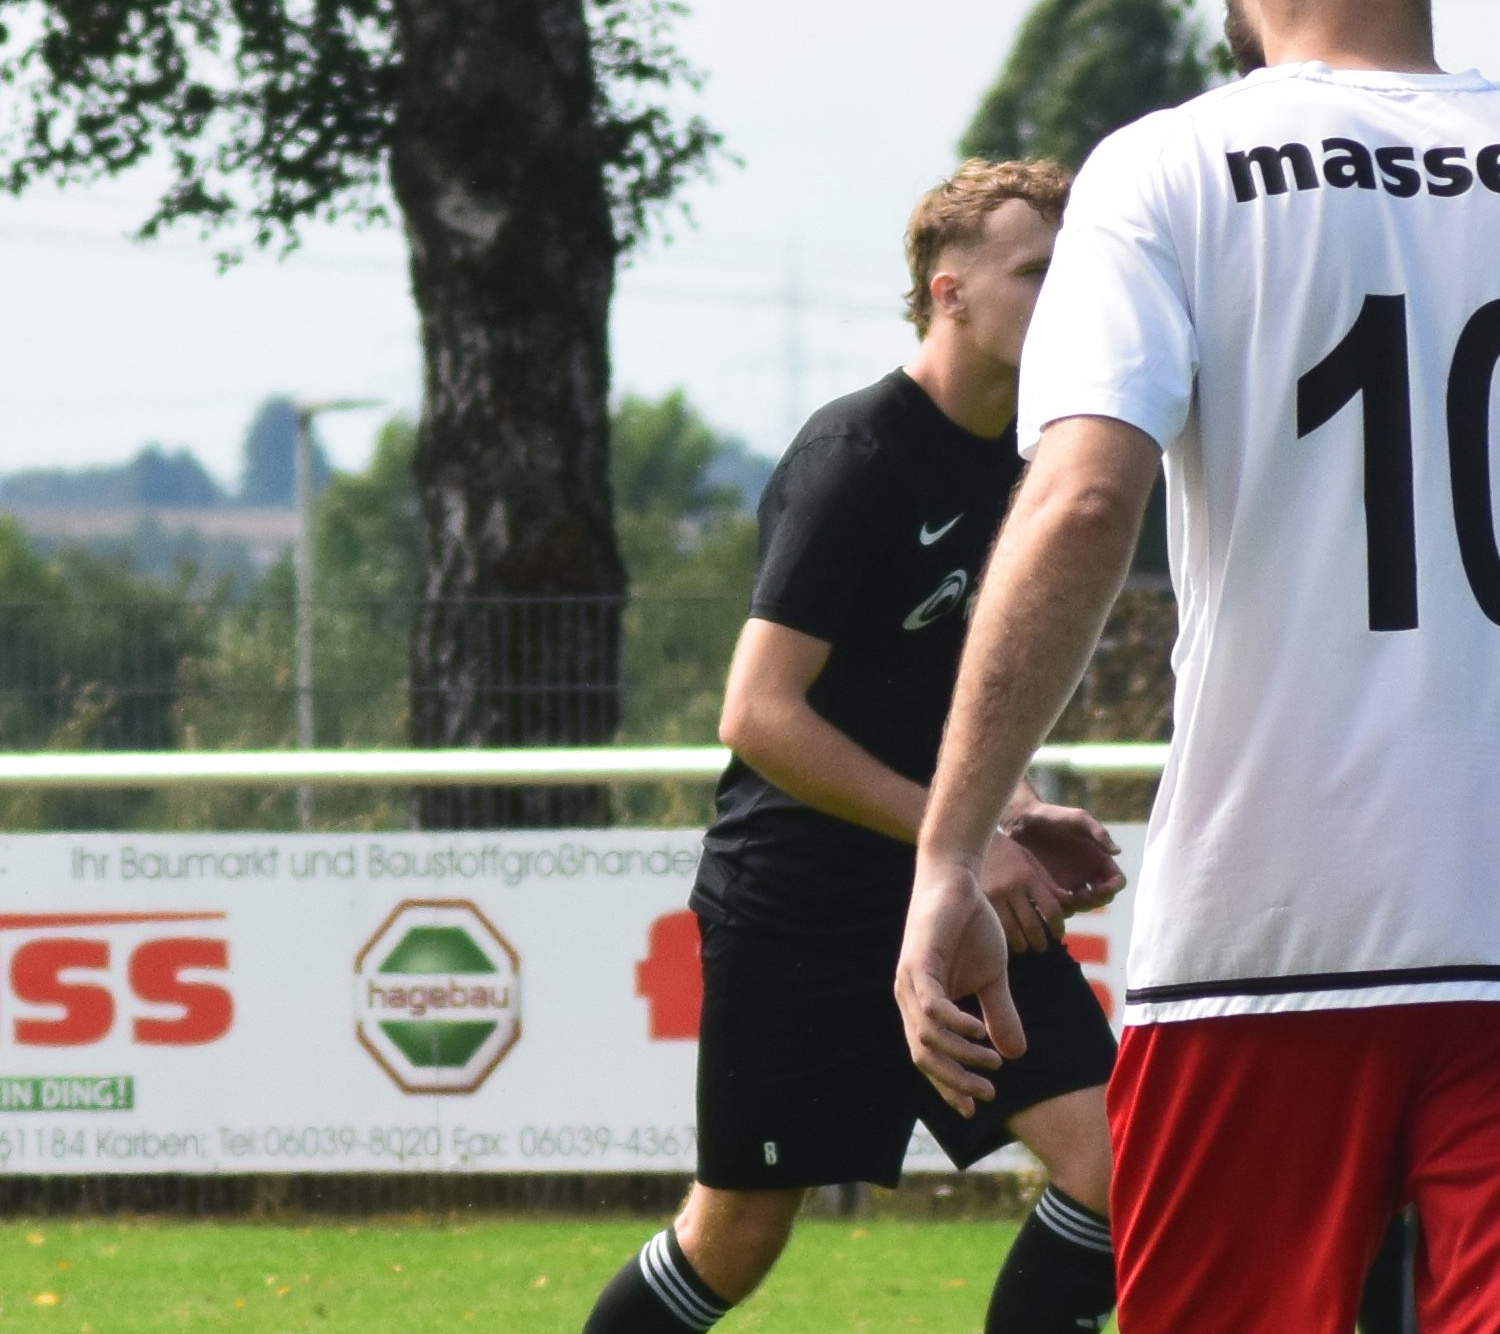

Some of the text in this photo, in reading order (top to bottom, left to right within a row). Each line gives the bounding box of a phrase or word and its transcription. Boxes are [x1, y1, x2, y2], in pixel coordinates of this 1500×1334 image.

[70, 842, 698, 886] Ihr Baumarkt und Baustoffgroßhande
[366, 979, 511, 1015] hagebau
[40, 1078, 131, 1109] DING!
[763, 1141, 778, 1166] 8
